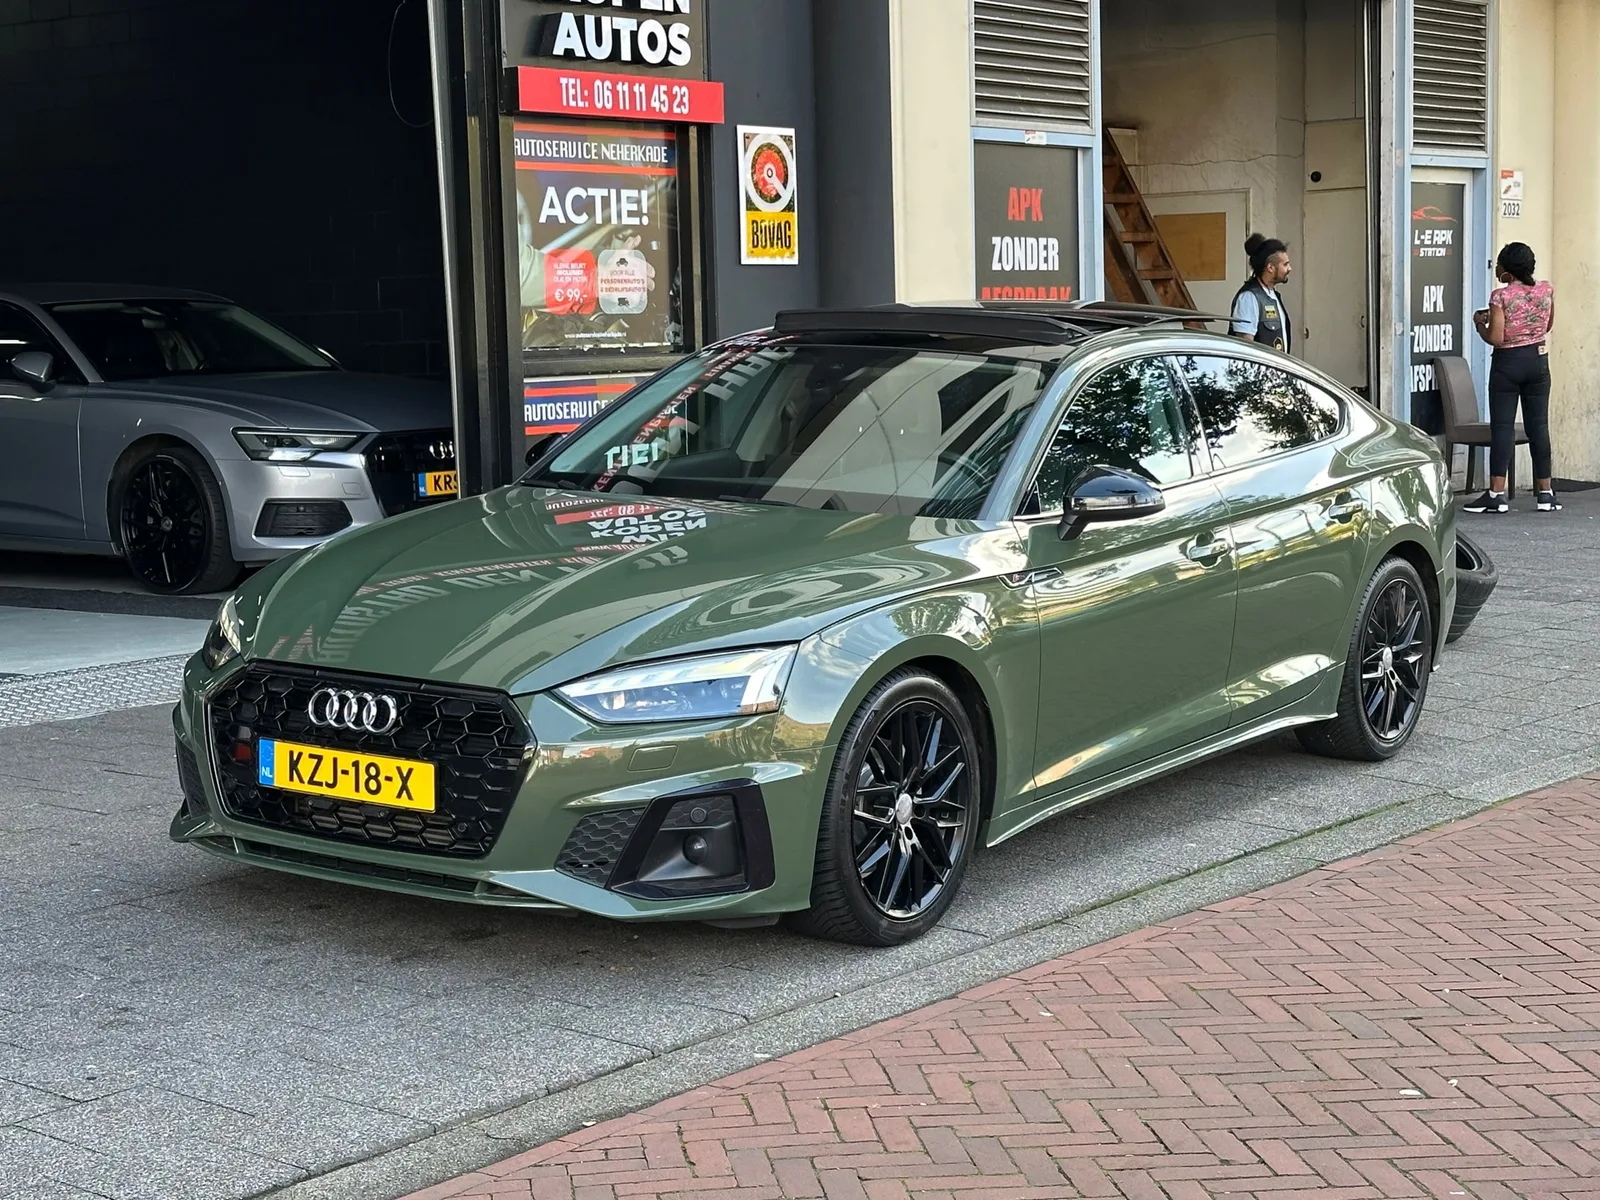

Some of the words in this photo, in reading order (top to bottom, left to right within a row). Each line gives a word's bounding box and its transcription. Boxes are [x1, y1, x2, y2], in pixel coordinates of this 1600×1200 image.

[552, 11, 692, 67] AUTOS
[560, 76, 589, 108] TEL:
[593, 79, 613, 110] 06
[616, 81, 630, 111] 11
[633, 83, 647, 112] 11
[650, 84, 669, 114] 45
[672, 85, 689, 115] 23
[514, 137, 598, 160] AUTOSERVICE
[601, 143, 668, 163] NEHERKADE
[538, 186, 649, 226] ACTIE!
[1007, 187, 1043, 222] APK
[1503, 202, 1520, 216] 2032
[751, 219, 792, 250] BOVAG
[991, 236, 1060, 271] ZONDER
[1423, 285, 1444, 313] APK
[1413, 324, 1453, 353] ZONDER
[261, 766, 273, 778] NL
[288, 750, 415, 801] KZJ-18-X
